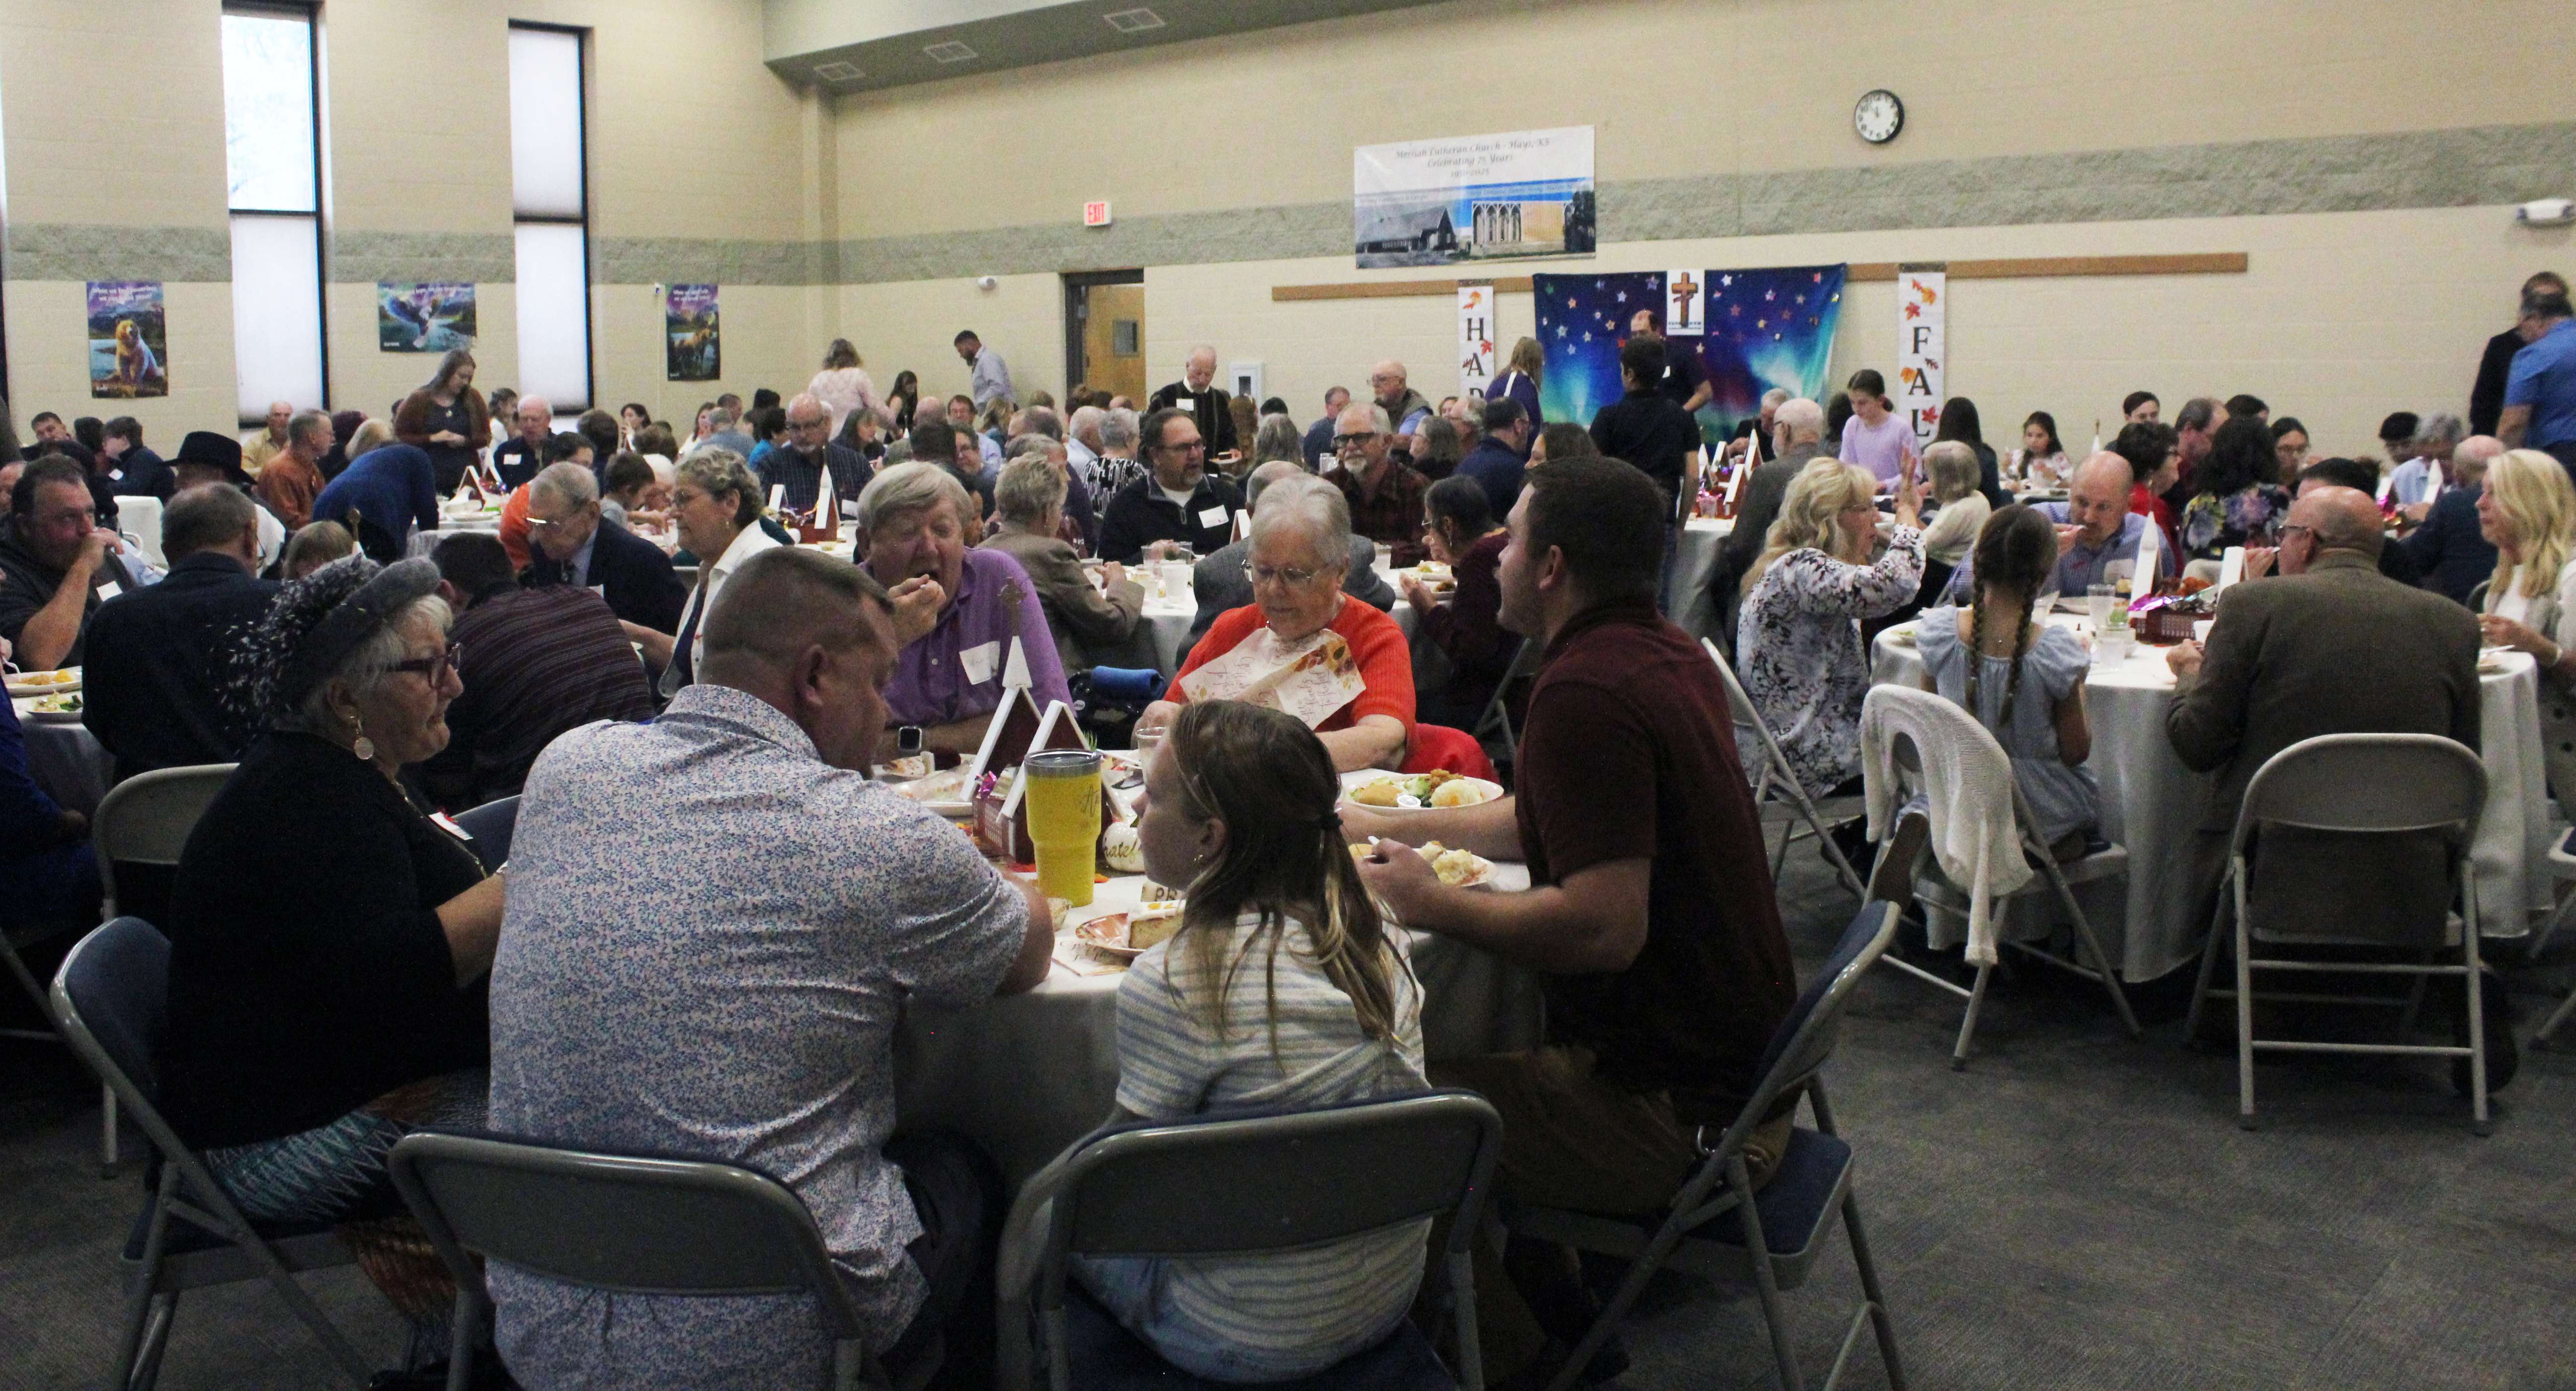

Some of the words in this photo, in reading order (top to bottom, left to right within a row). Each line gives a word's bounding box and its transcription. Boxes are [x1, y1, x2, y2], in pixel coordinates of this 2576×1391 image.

[1430, 146, 1467, 156] Lutheran
[1470, 141, 1500, 151] Church
[1428, 157, 1475, 167] Celebrating
[1490, 154, 1513, 164] Years
[1088, 204, 1105, 224] EXIT
